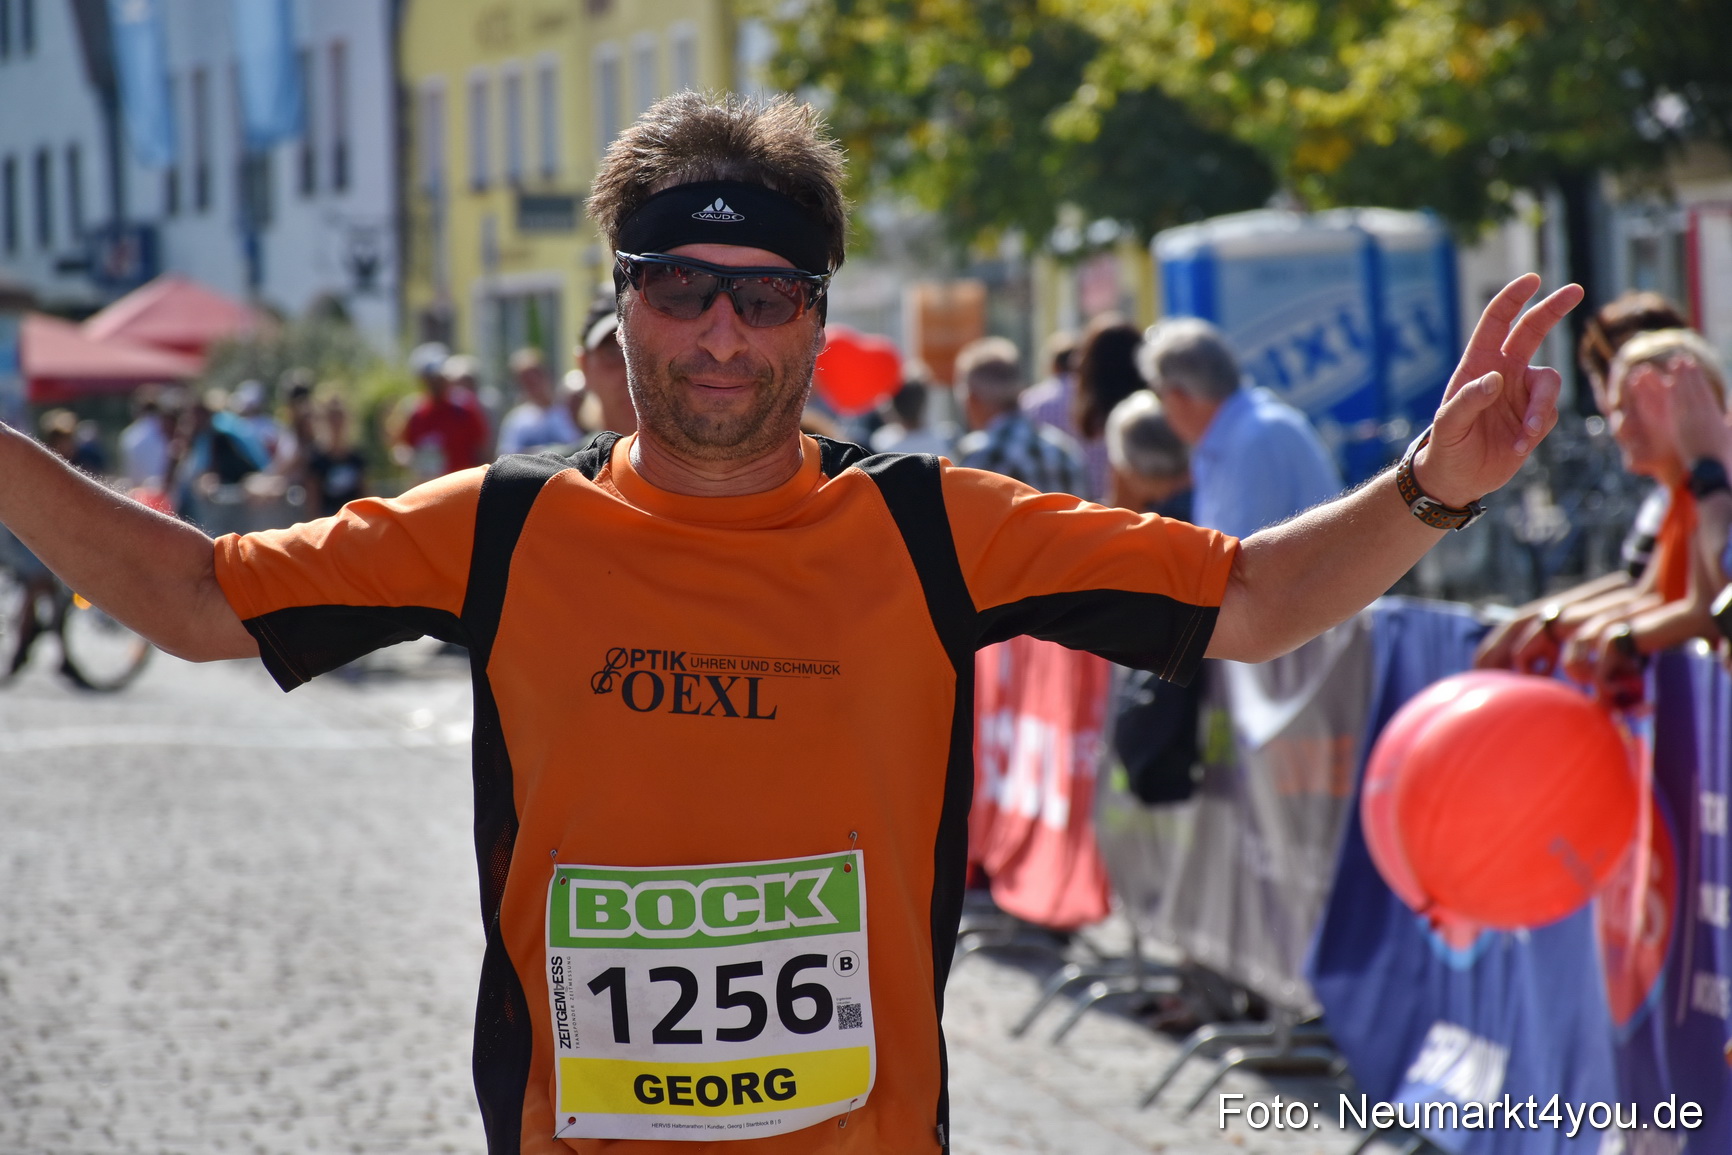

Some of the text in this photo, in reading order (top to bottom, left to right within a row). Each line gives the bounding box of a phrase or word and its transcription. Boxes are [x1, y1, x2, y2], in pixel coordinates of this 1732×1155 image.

[690, 657, 841, 676] UHREN UND SCHMUCK
[621, 670, 778, 720] OEXL
[573, 872, 832, 935] BOCK
[566, 956, 574, 1001] ZEITMESSUNG
[839, 956, 853, 971] B
[587, 954, 834, 1044] 1256
[570, 1005, 580, 1049] TRANSPONDER
[633, 1068, 797, 1107] GEORG
